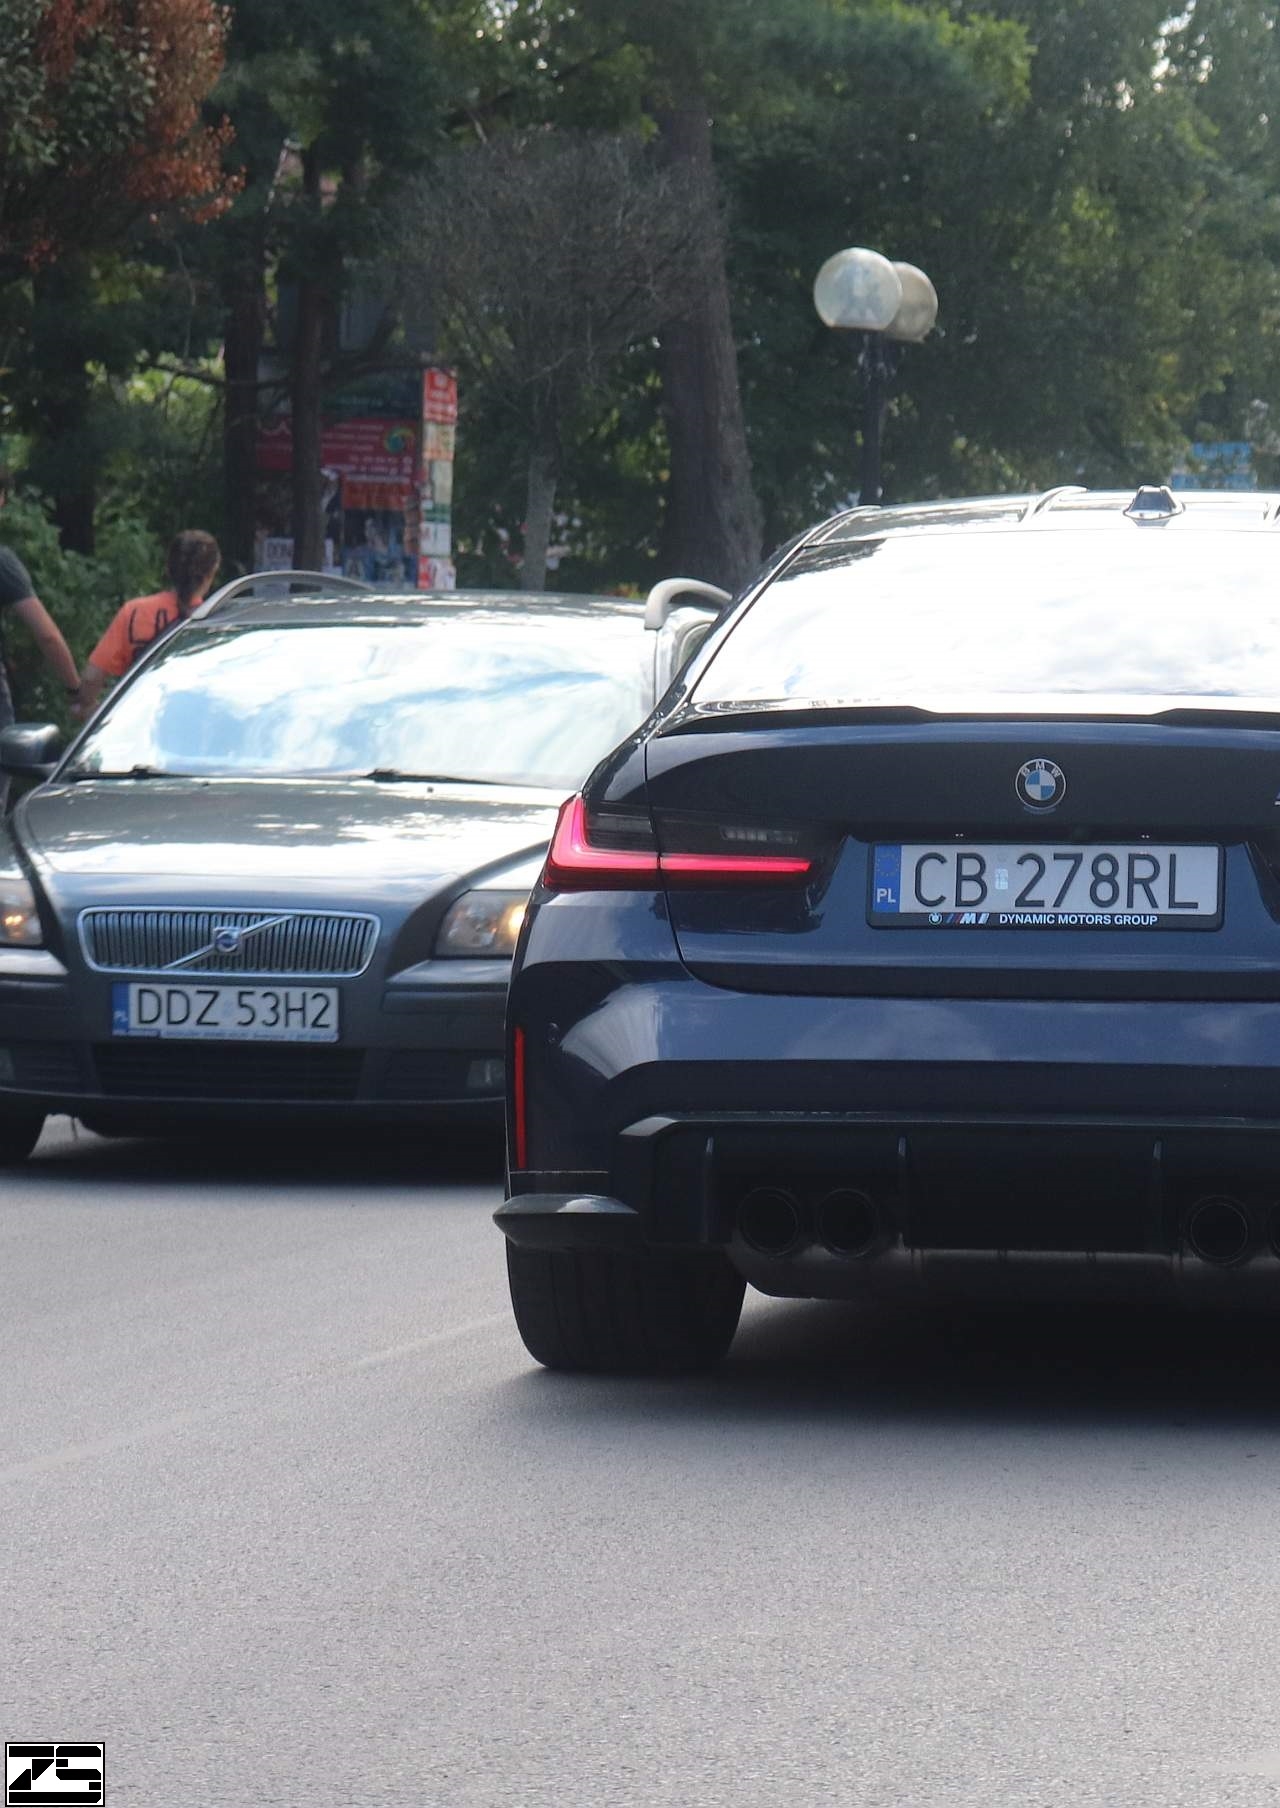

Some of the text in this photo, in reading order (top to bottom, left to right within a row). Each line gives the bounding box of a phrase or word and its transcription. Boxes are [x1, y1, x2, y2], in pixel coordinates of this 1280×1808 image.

[1019, 759, 1062, 779] BMW
[914, 852, 1199, 909] CB 278RL
[876, 888, 897, 903] PL
[999, 913, 1056, 925] DYNAMIC
[1058, 914, 1112, 925] MOTORS
[1113, 914, 1158, 926] GROUP
[137, 988, 331, 1029] DDZ 53H2
